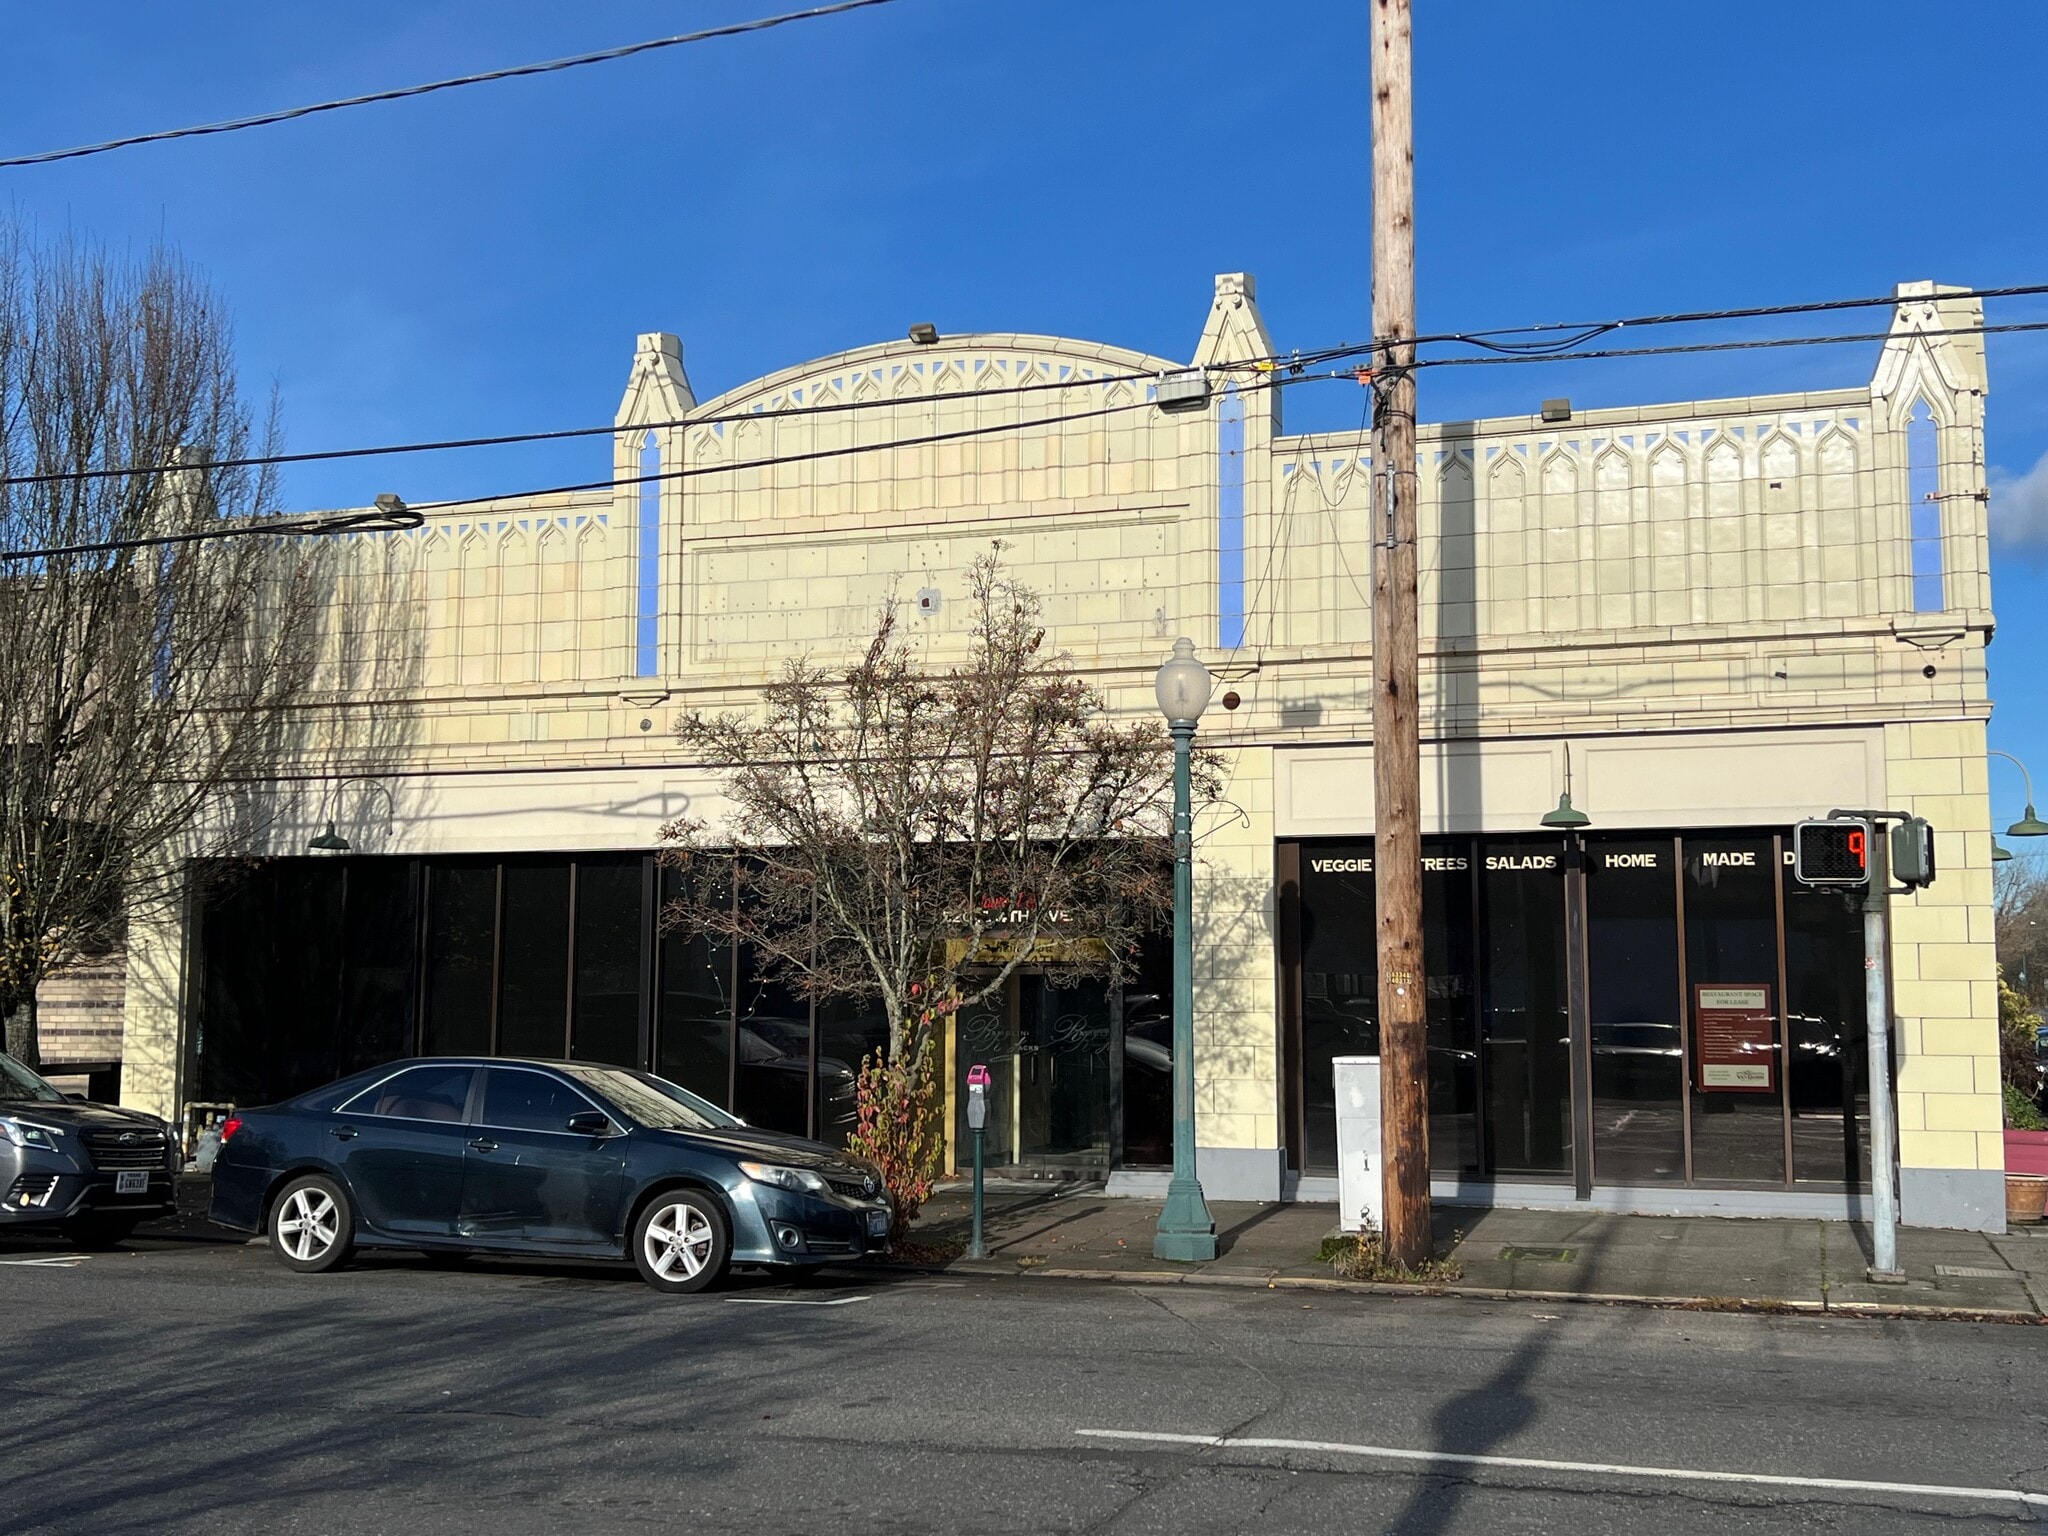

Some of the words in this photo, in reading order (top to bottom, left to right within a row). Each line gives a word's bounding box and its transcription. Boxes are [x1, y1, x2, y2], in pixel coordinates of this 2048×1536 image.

[1311, 858, 1373, 873] VEGGIE
[1485, 855, 1557, 870] SALADS
[1604, 853, 1657, 868] HOME
[1702, 851, 1756, 867] MADE
[1848, 832, 1865, 868] 9
